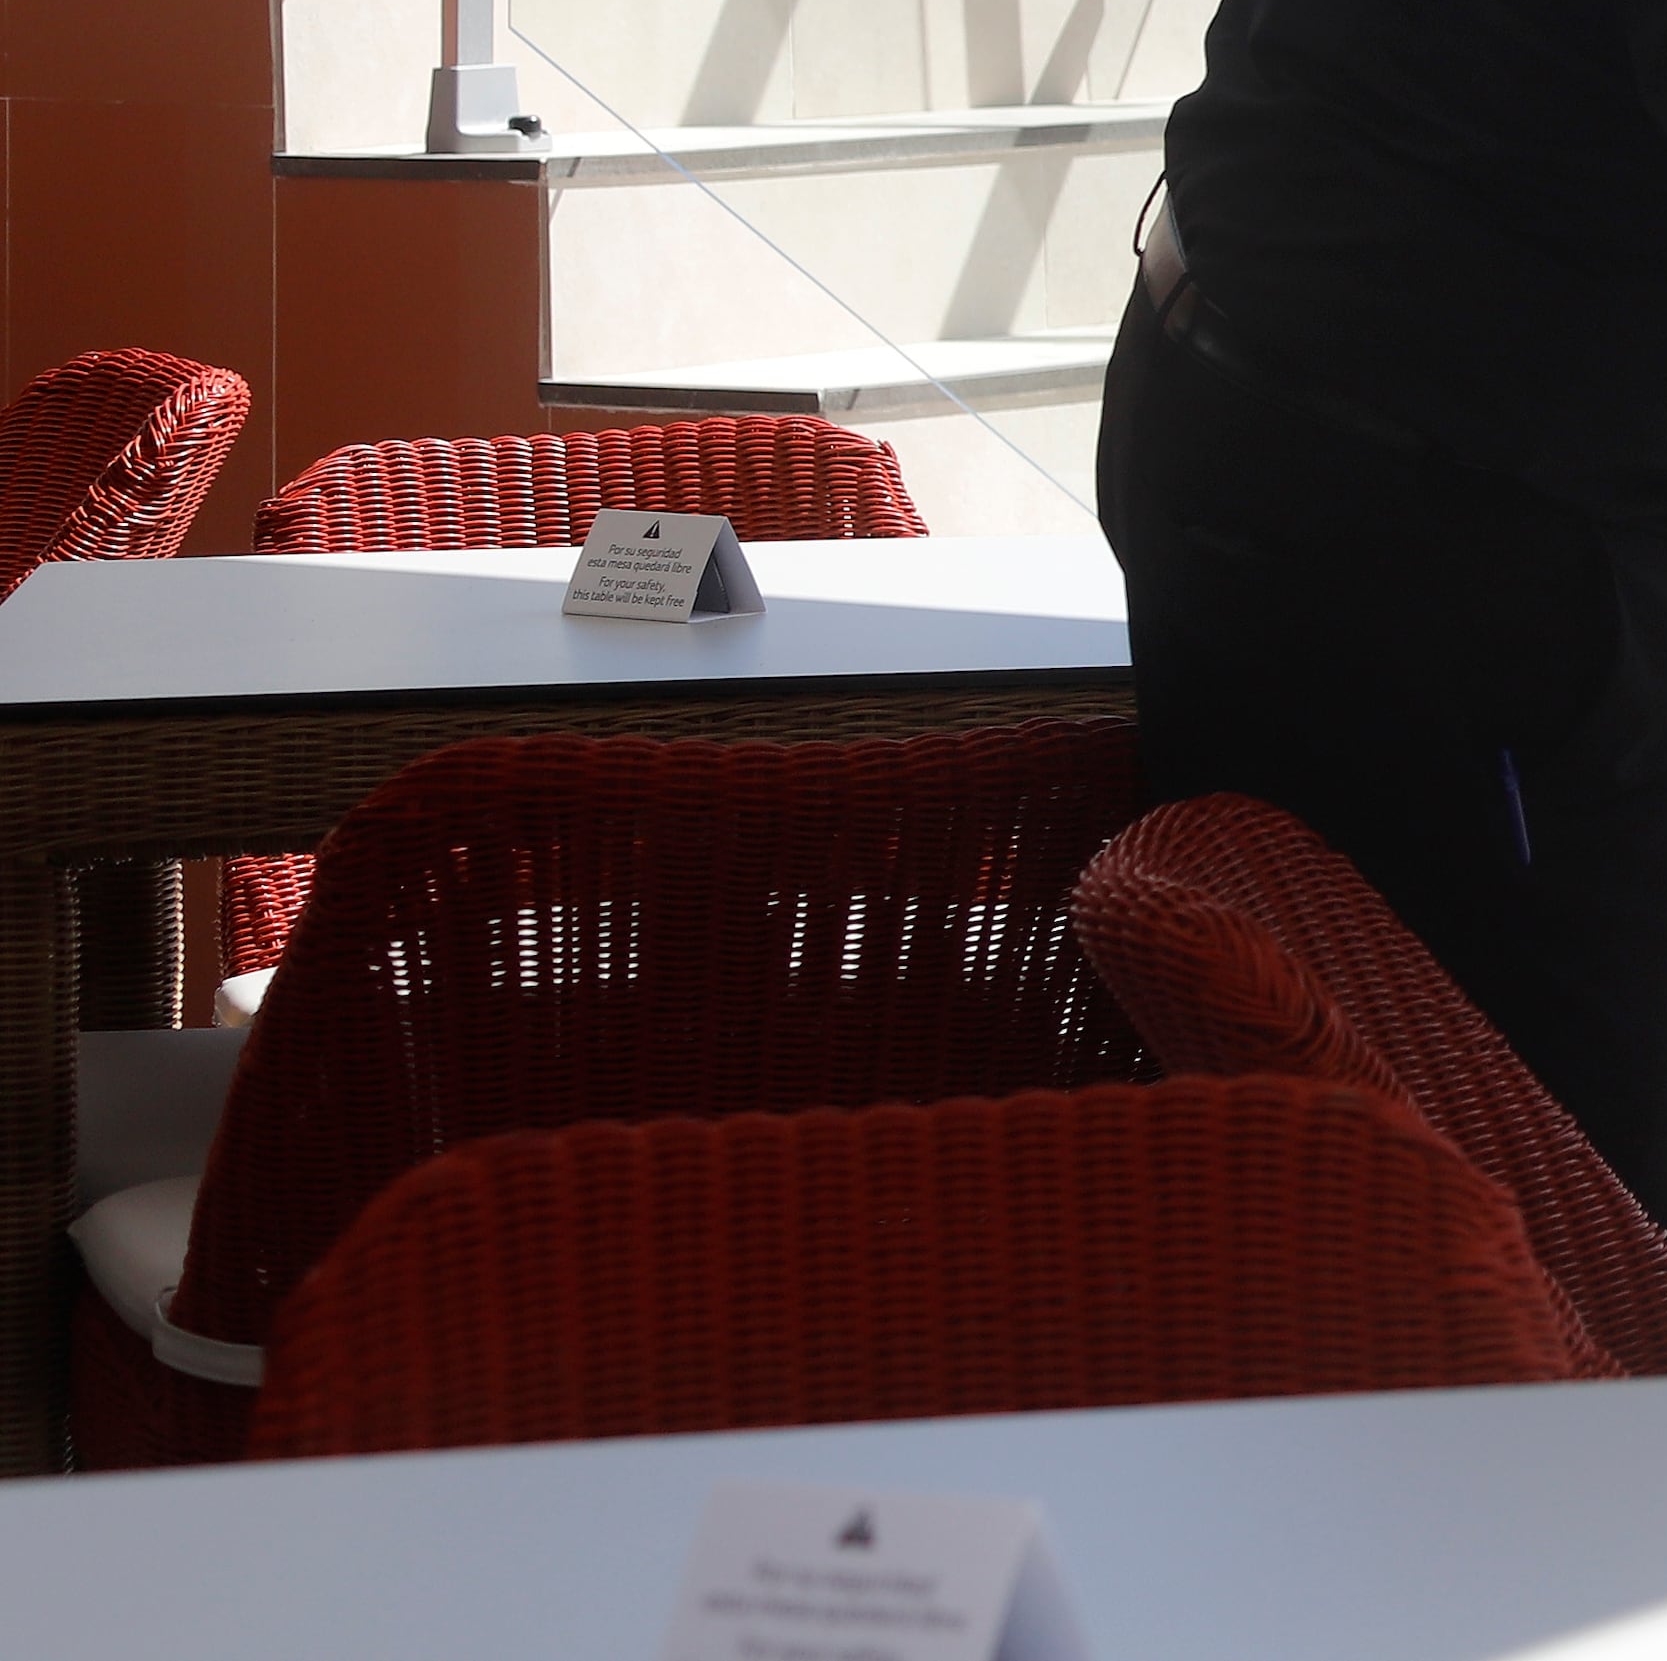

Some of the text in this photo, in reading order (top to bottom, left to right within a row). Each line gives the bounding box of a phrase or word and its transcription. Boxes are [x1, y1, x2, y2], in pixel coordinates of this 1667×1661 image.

[608, 544, 682, 559] Por su seguridad
[587, 558, 692, 573] esta mesa quedará libre
[599, 576, 665, 594] For your safety,
[573, 589, 685, 607] this table will be kept free
